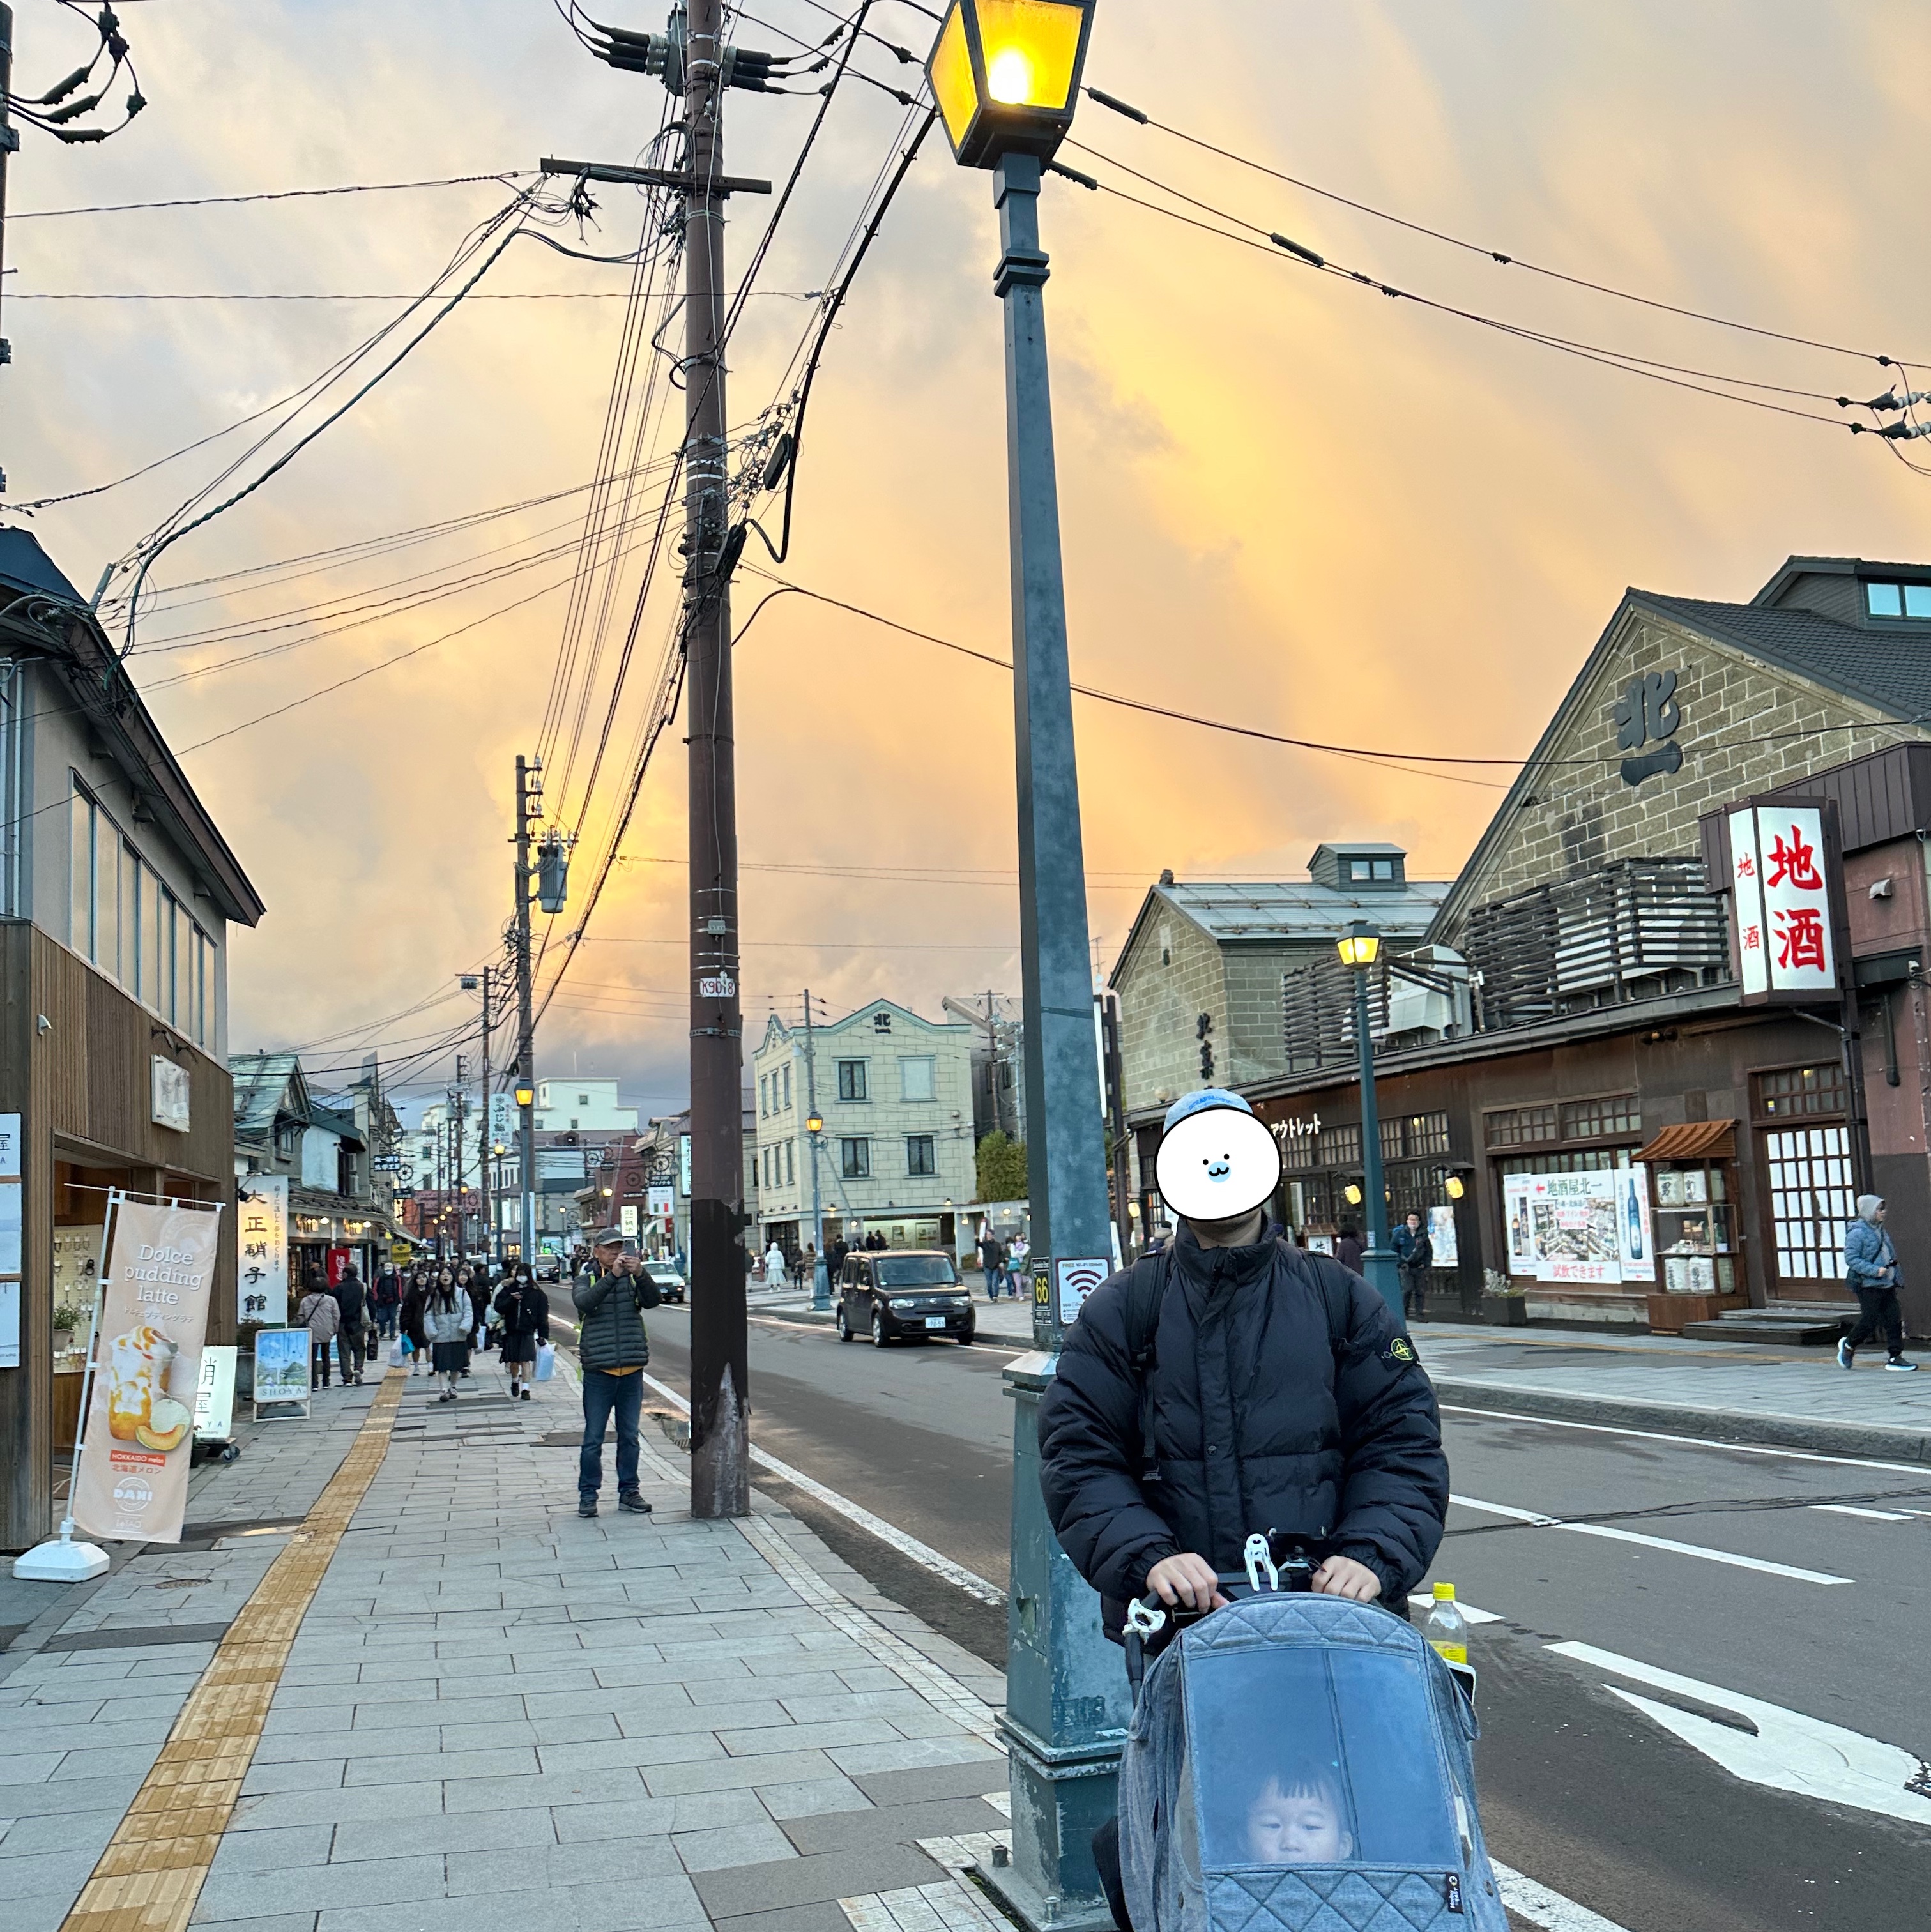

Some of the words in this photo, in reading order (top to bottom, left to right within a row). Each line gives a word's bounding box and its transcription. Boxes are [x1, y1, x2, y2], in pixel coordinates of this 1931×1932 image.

[1614, 669, 1683, 786] 北一
[1737, 852, 1760, 951] 地酒
[1767, 825, 1826, 972] 地酒
[874, 1013, 891, 1034] 北一
[1271, 1113, 1321, 1138] アウトレット
[1548, 1178, 1603, 1196] 地酒屋北一
[138, 1245, 194, 1265] Dolce
[244, 1190, 268, 1312] 大正硝子館
[125, 1266, 203, 1291] pudding
[1553, 1264, 1605, 1279] 試飲できます
[137, 1285, 179, 1304] latte
[1036, 1277, 1048, 1303] 66
[112, 1453, 147, 1462] HOKKAIDO
[112, 1464, 161, 1474] 北海道メロン
